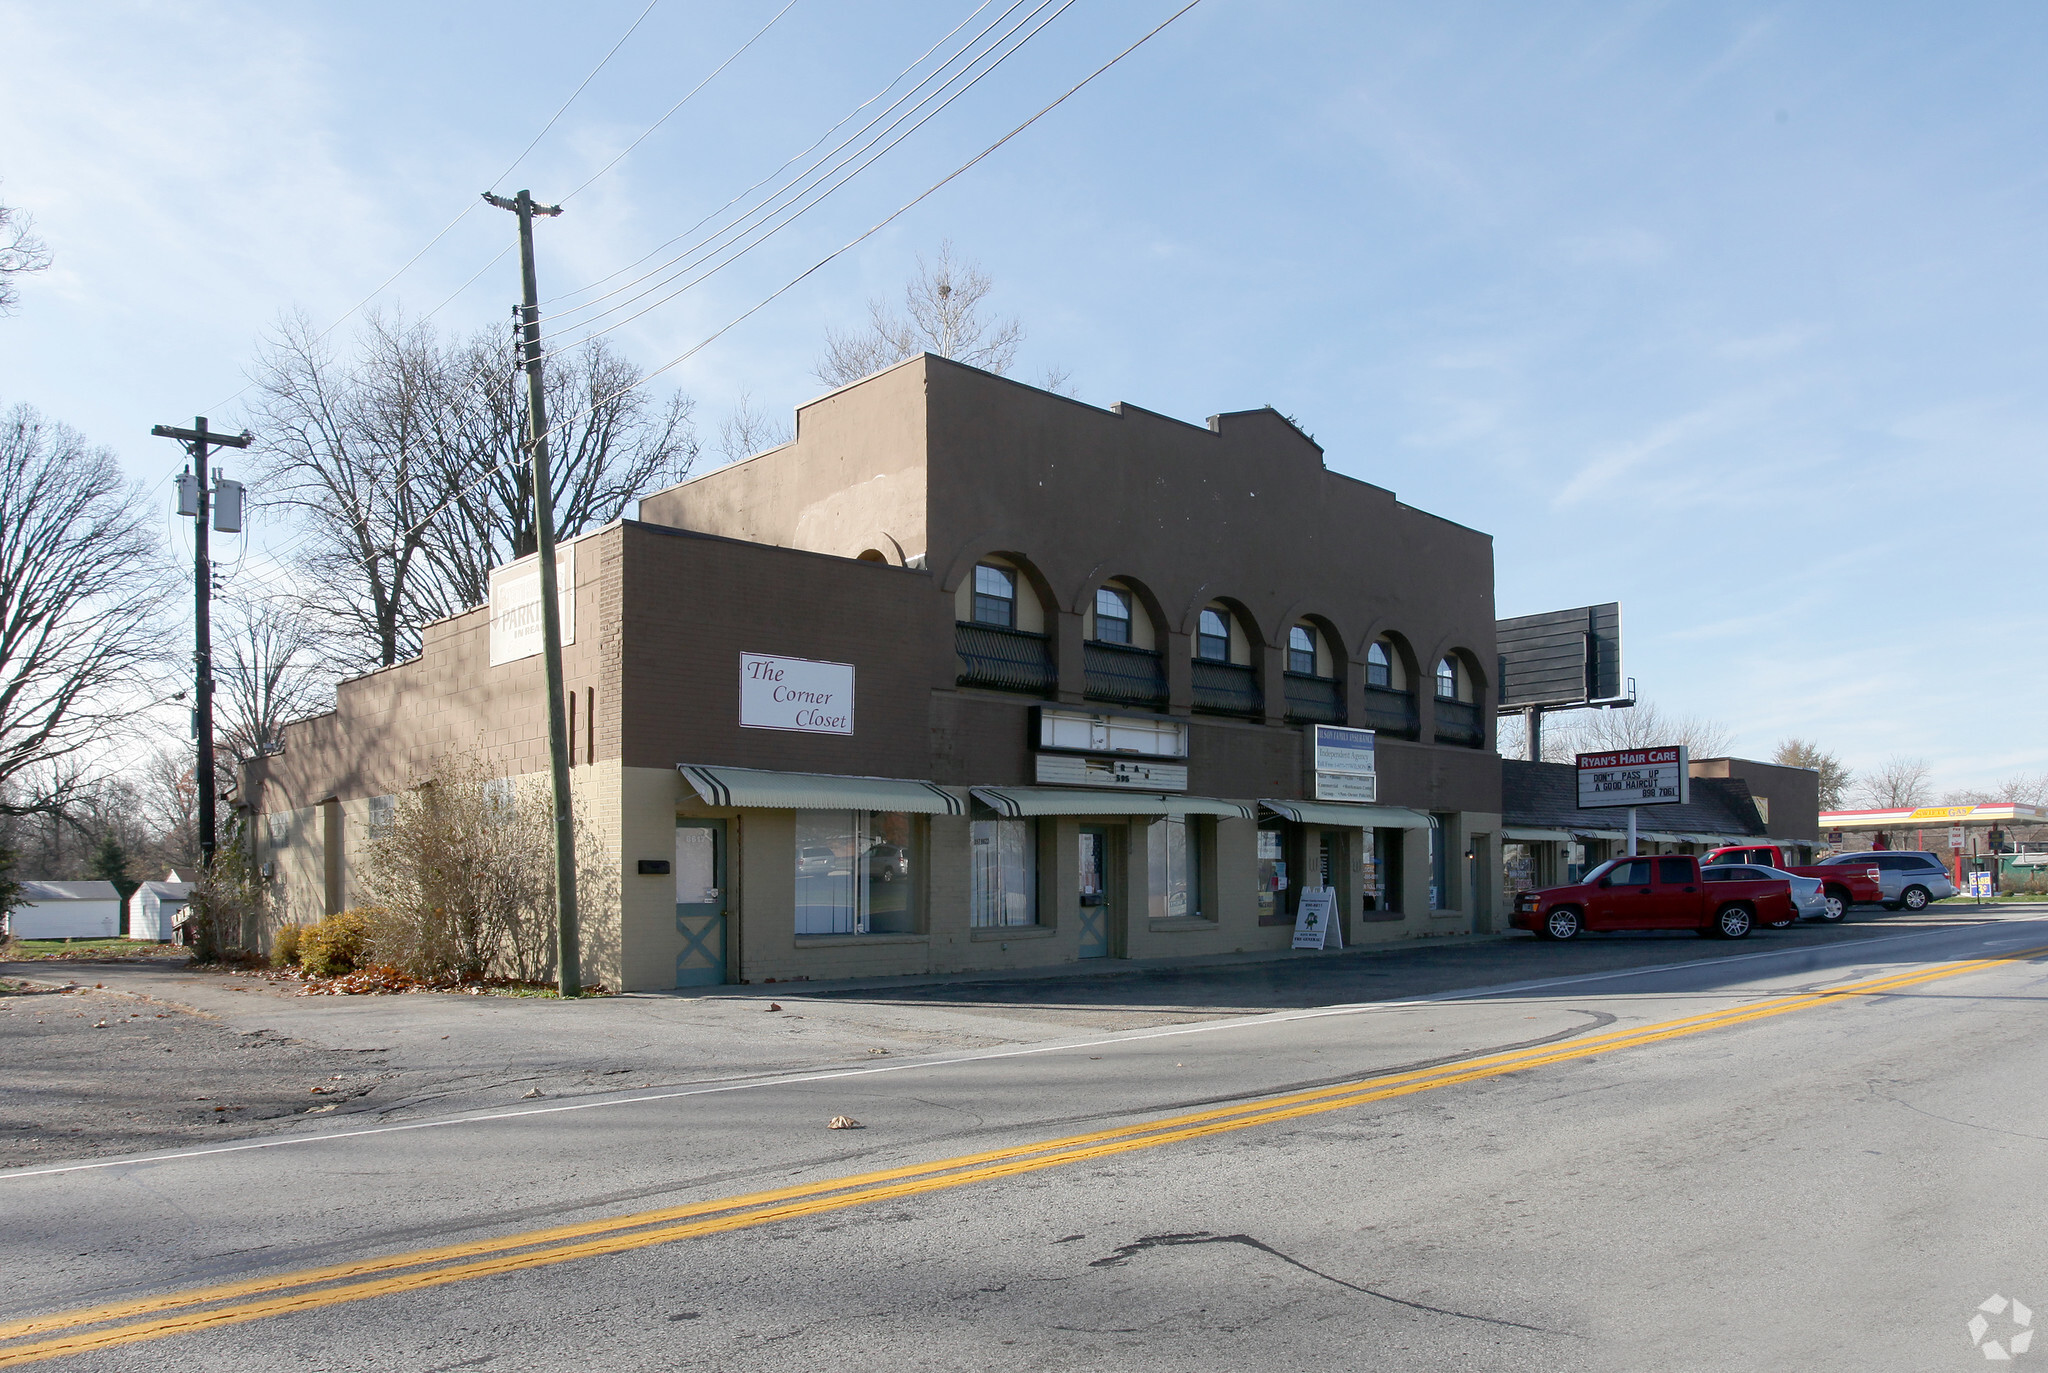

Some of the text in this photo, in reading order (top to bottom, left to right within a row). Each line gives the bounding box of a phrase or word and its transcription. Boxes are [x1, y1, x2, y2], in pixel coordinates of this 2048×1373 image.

[514, 623, 542, 639] IN REA
[747, 660, 785, 682] The
[773, 685, 833, 705] Corner
[795, 708, 847, 728] Closet
[1319, 748, 1369, 763] Independent Agency
[1581, 751, 1677, 768] RYAN'S HAIR CARE
[1593, 769, 1660, 783] DON'T PASS UP
[1595, 779, 1659, 792] A GOOD HAIRCUT
[1659, 787, 1675, 797] 7061
[1947, 807, 1967, 818] GAS
